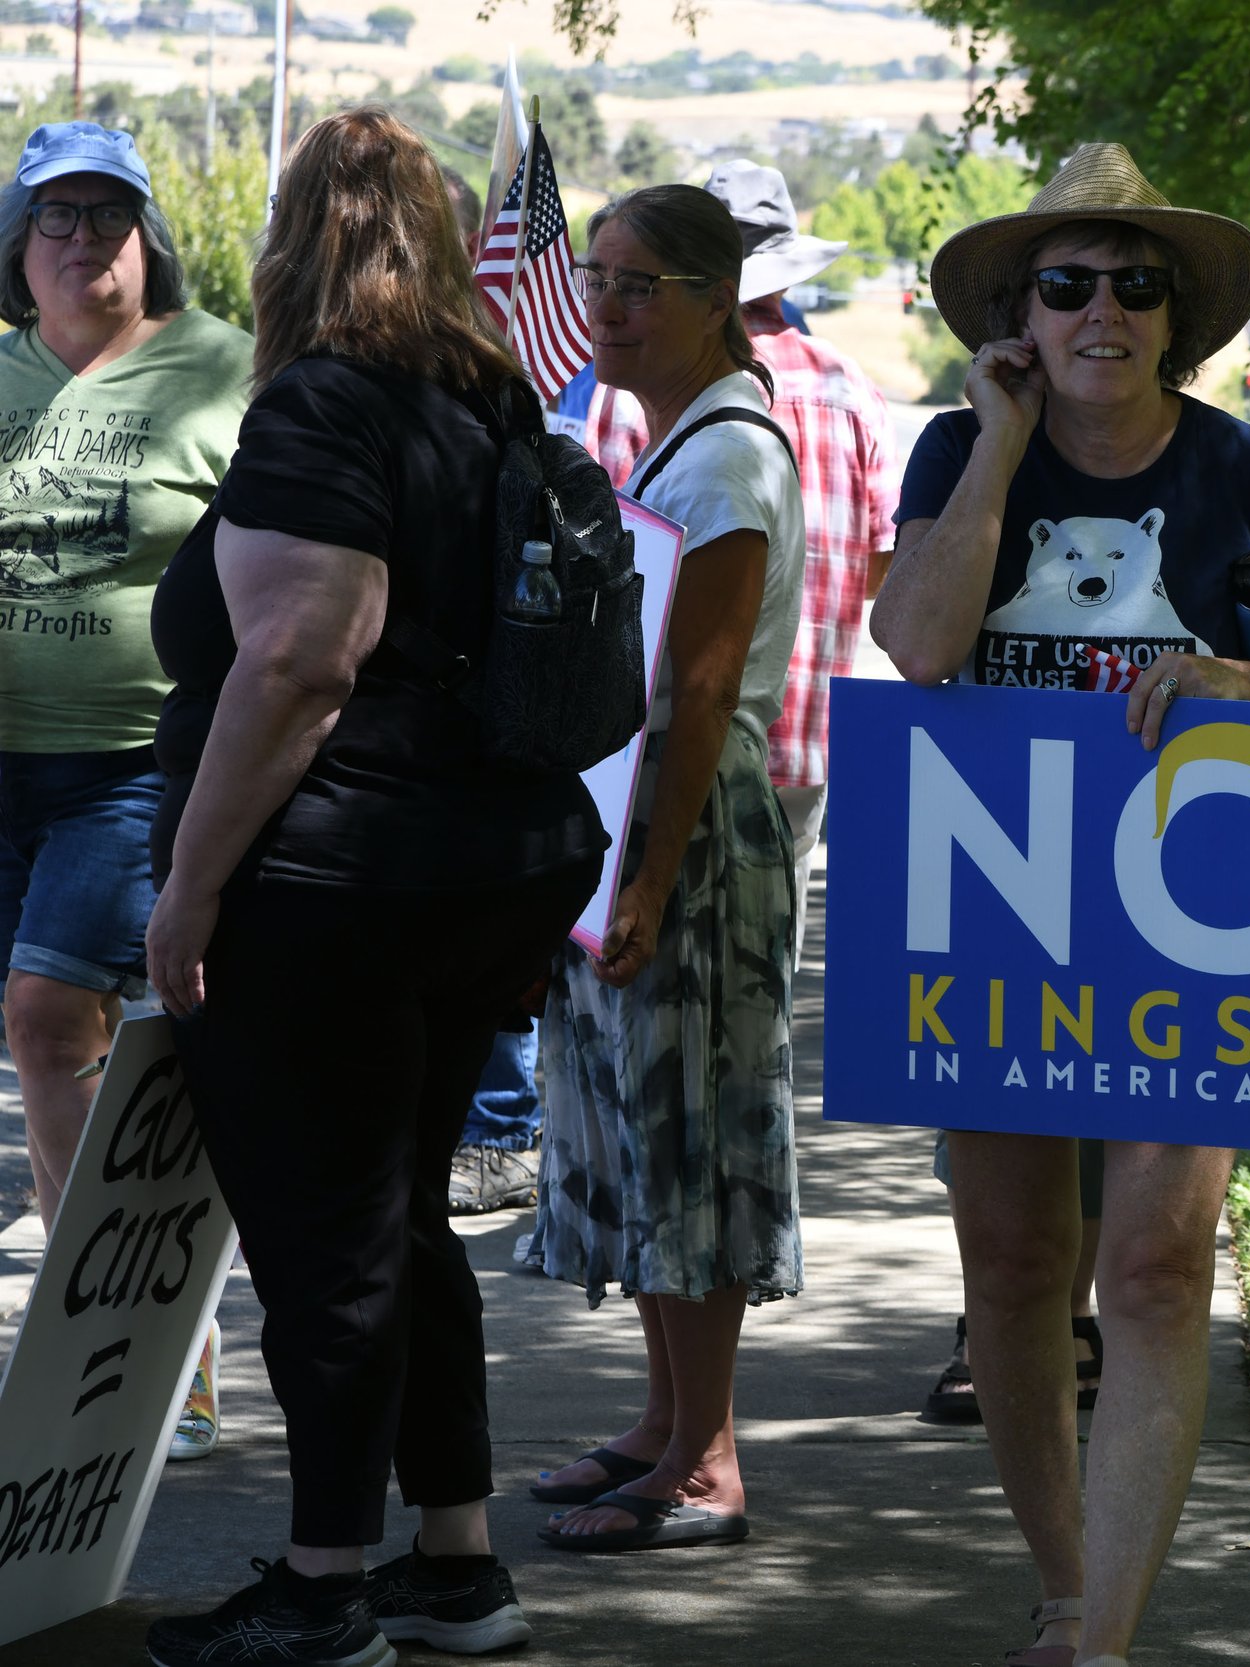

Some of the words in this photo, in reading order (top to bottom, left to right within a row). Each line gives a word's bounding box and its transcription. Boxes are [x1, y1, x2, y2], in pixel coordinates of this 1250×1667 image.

[0, 408, 88, 422] OTECT
[106, 413, 151, 431] OUR
[73, 429, 149, 469] PARKS
[60, 466, 94, 478] Defund
[22, 609, 112, 641] Profits
[986, 638, 1039, 666] LET
[1055, 642, 1092, 668] US
[985, 666, 1076, 691] PAUSE
[908, 1050, 960, 1084] IN
[64, 1197, 212, 1318] CUTS
[0, 1447, 136, 1568] DEATH
